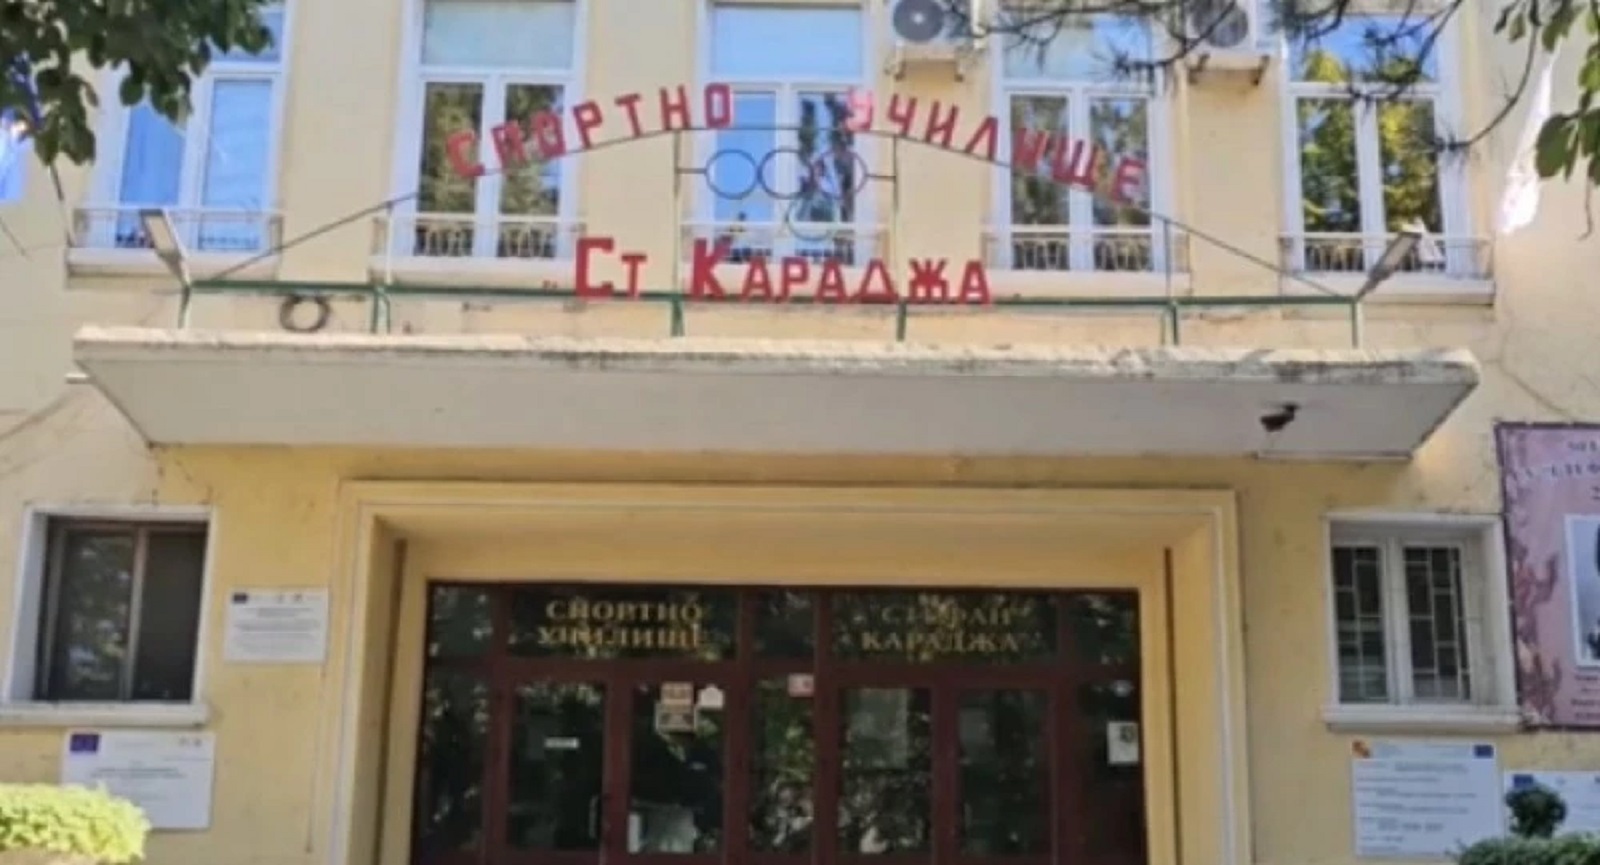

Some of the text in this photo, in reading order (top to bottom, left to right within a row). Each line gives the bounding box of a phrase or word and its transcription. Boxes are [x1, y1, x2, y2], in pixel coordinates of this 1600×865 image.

[446, 83, 1147, 205] СПОРТНО УЧИЛИЩЕ
[544, 598, 704, 622] СПОРТНО
[536, 625, 708, 649] УЧИЛИЩЕ
[860, 631, 1021, 654] КАРАДЖА
